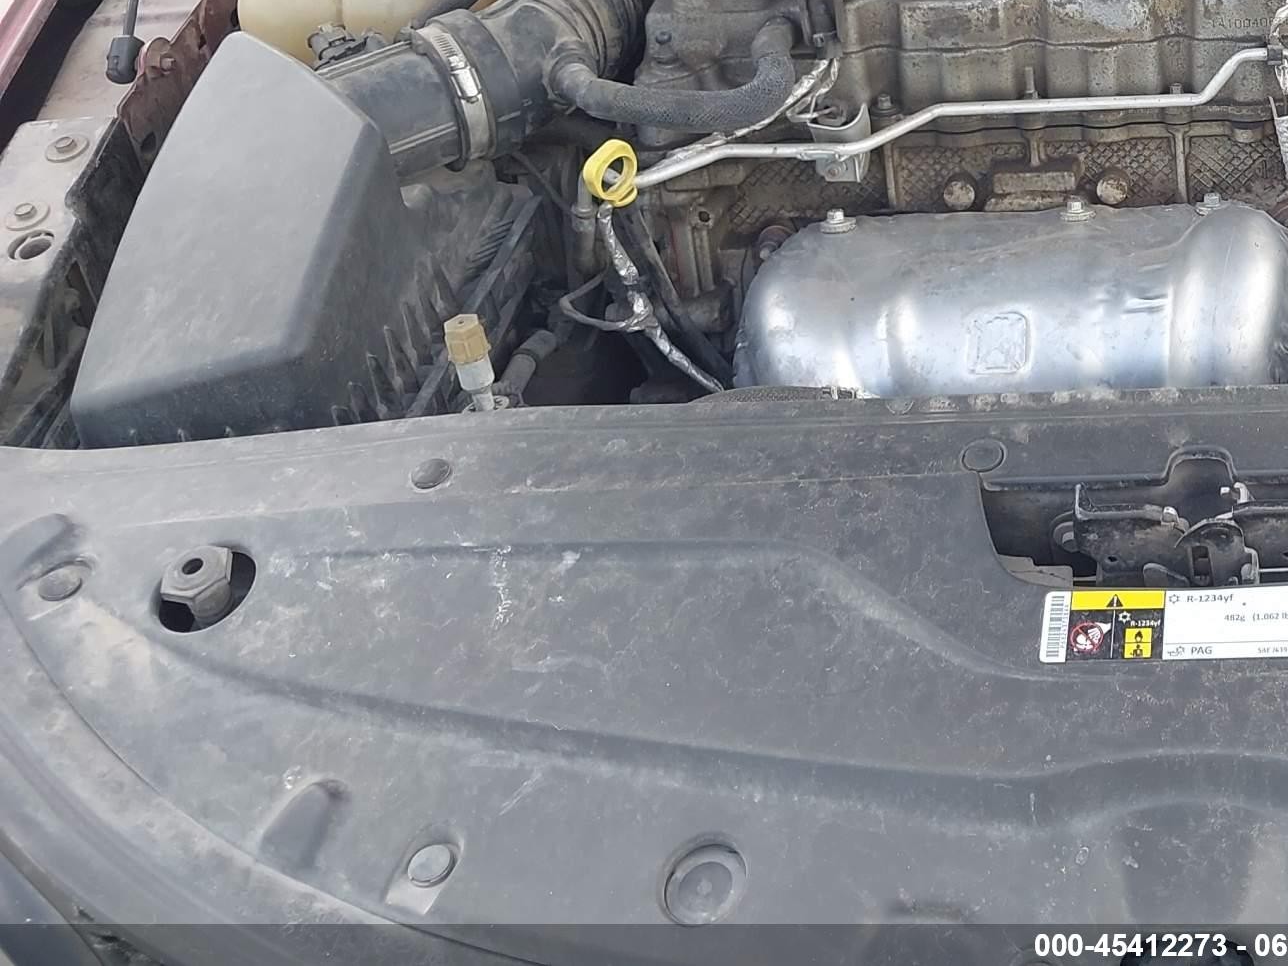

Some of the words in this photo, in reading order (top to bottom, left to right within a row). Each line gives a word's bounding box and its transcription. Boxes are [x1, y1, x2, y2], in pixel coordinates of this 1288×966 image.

[1186, 593, 1234, 604] R-1234yf
[1224, 613, 1246, 622] 482g
[1252, 612, 1279, 622] (1.062
[1190, 646, 1213, 656] PAG
